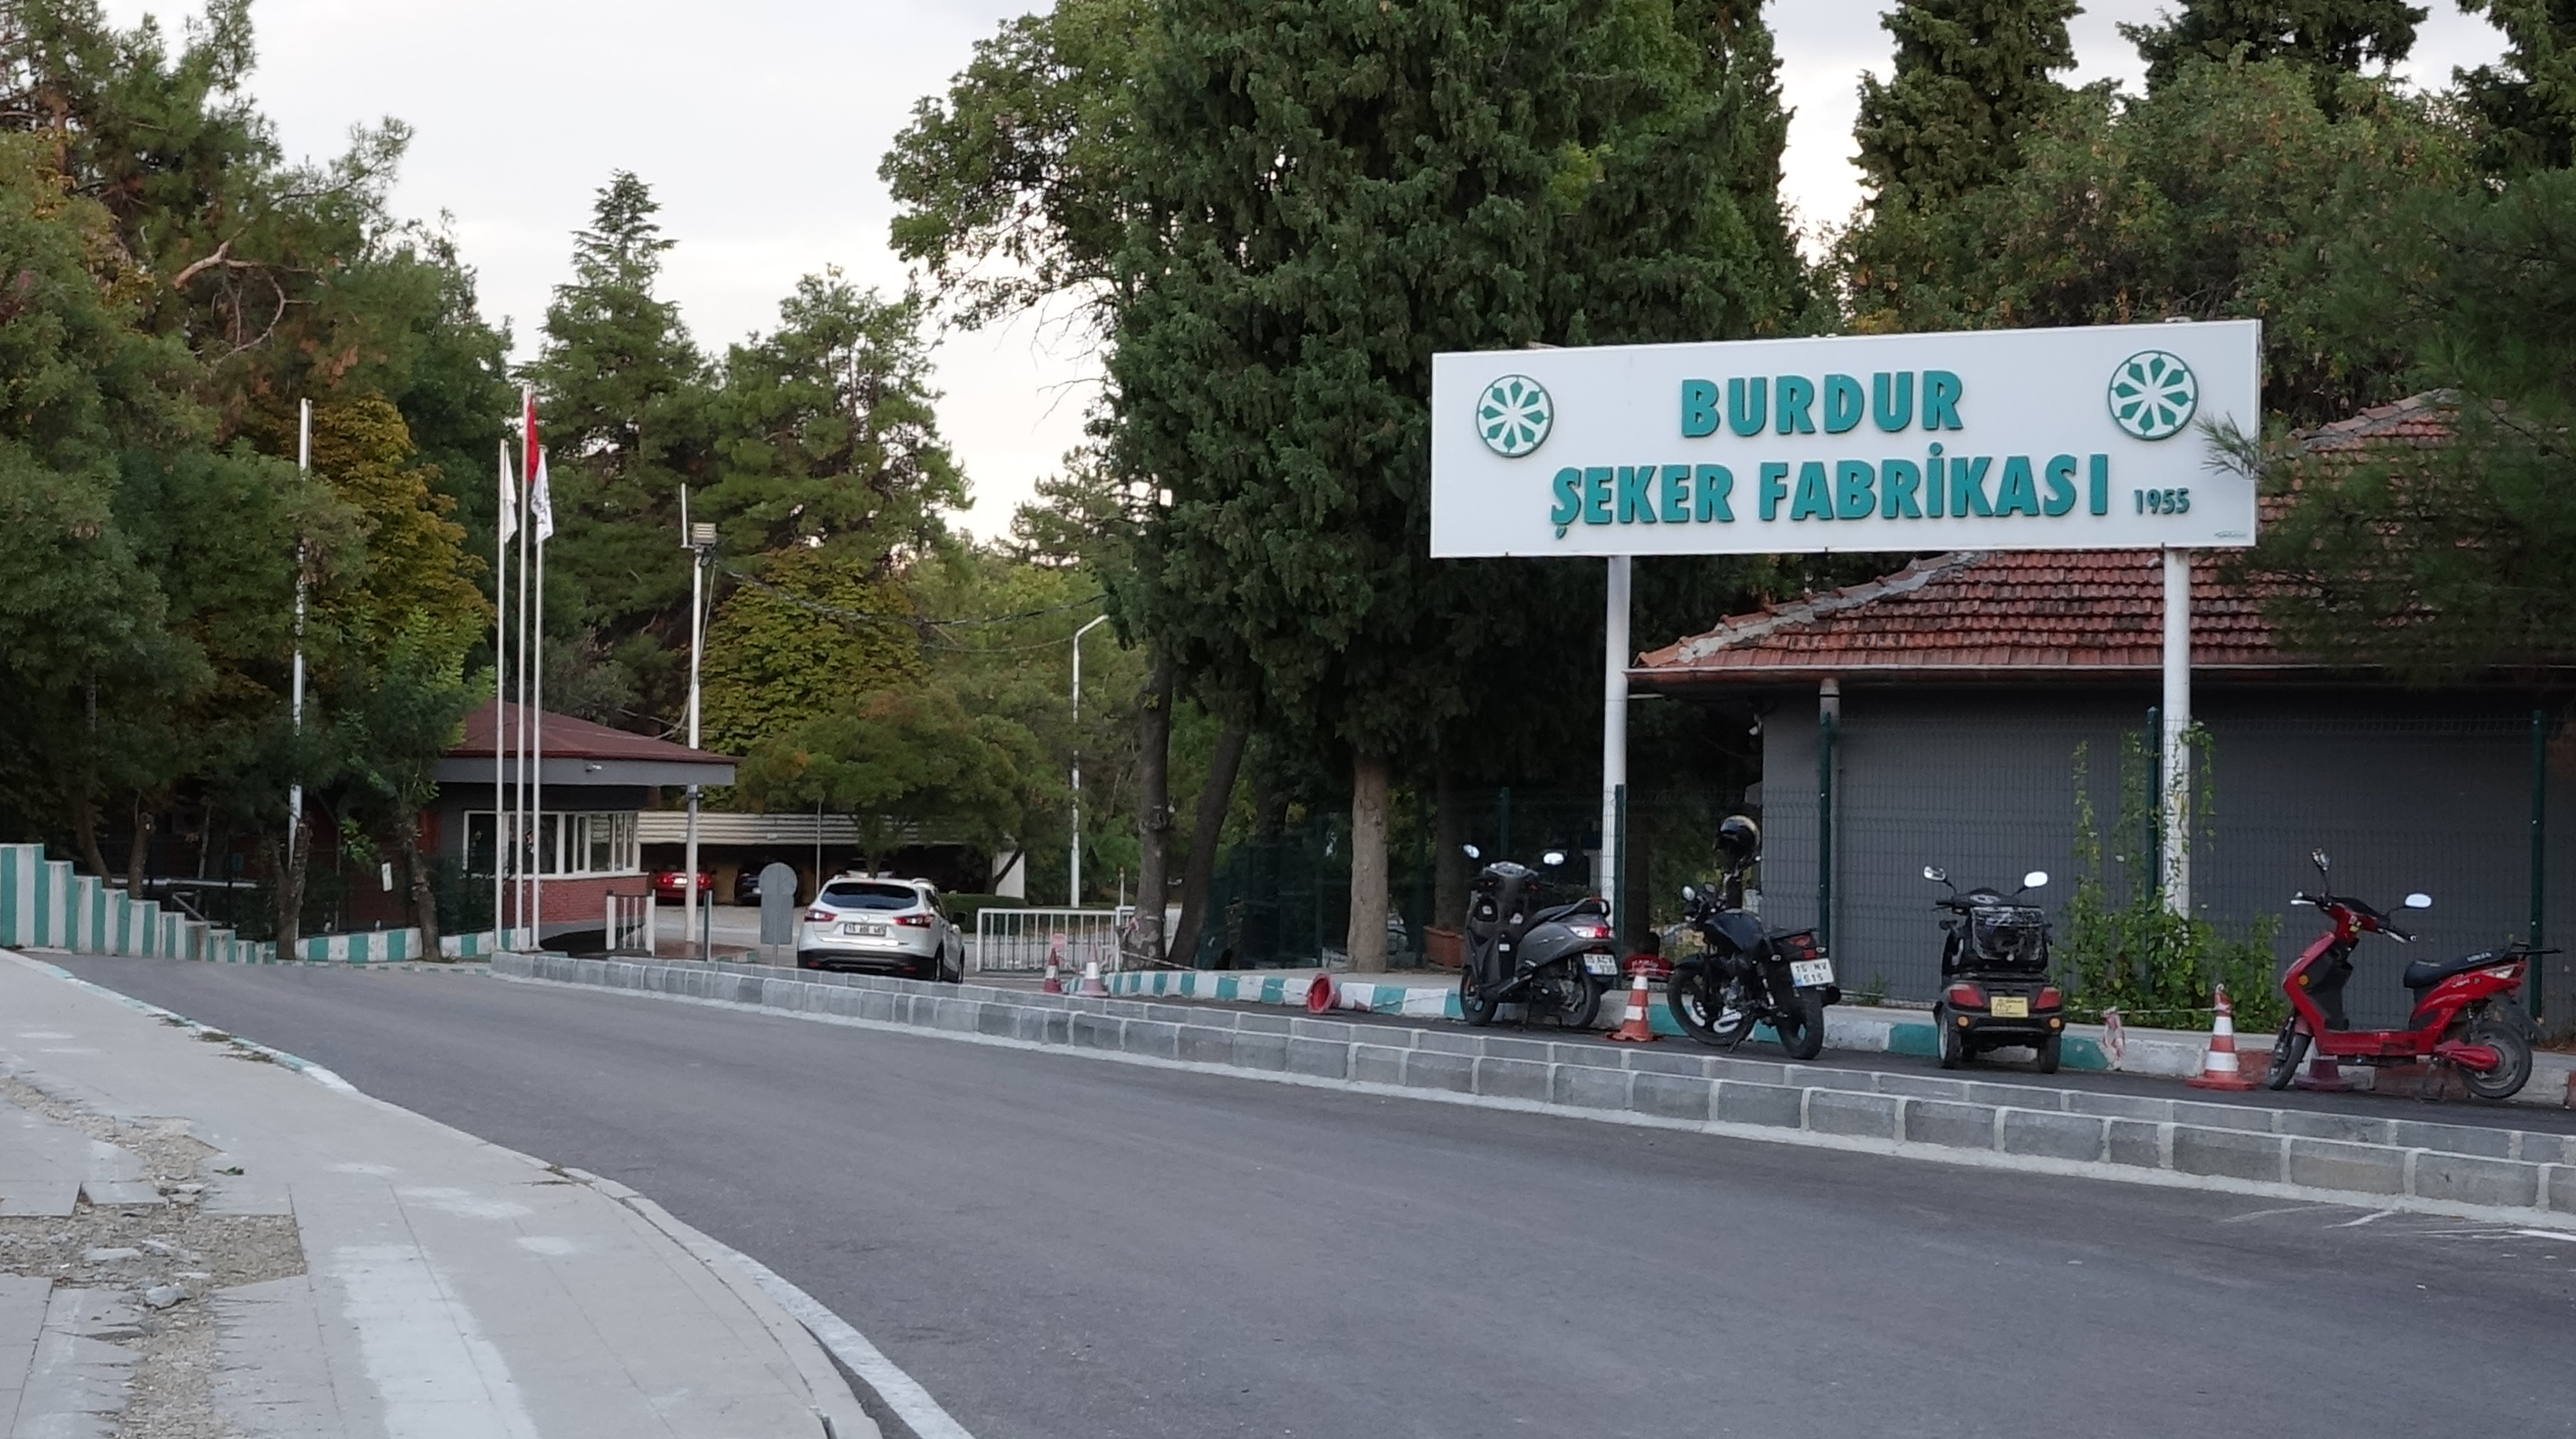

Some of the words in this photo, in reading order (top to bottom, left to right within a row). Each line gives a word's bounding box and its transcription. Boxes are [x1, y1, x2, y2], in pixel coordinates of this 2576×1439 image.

[1681, 369, 1963, 439] BURDUR
[1551, 462, 1735, 540] ŞEKER
[1758, 442, 2109, 521] FABRİKASI
[2134, 488, 2190, 514] 1955
